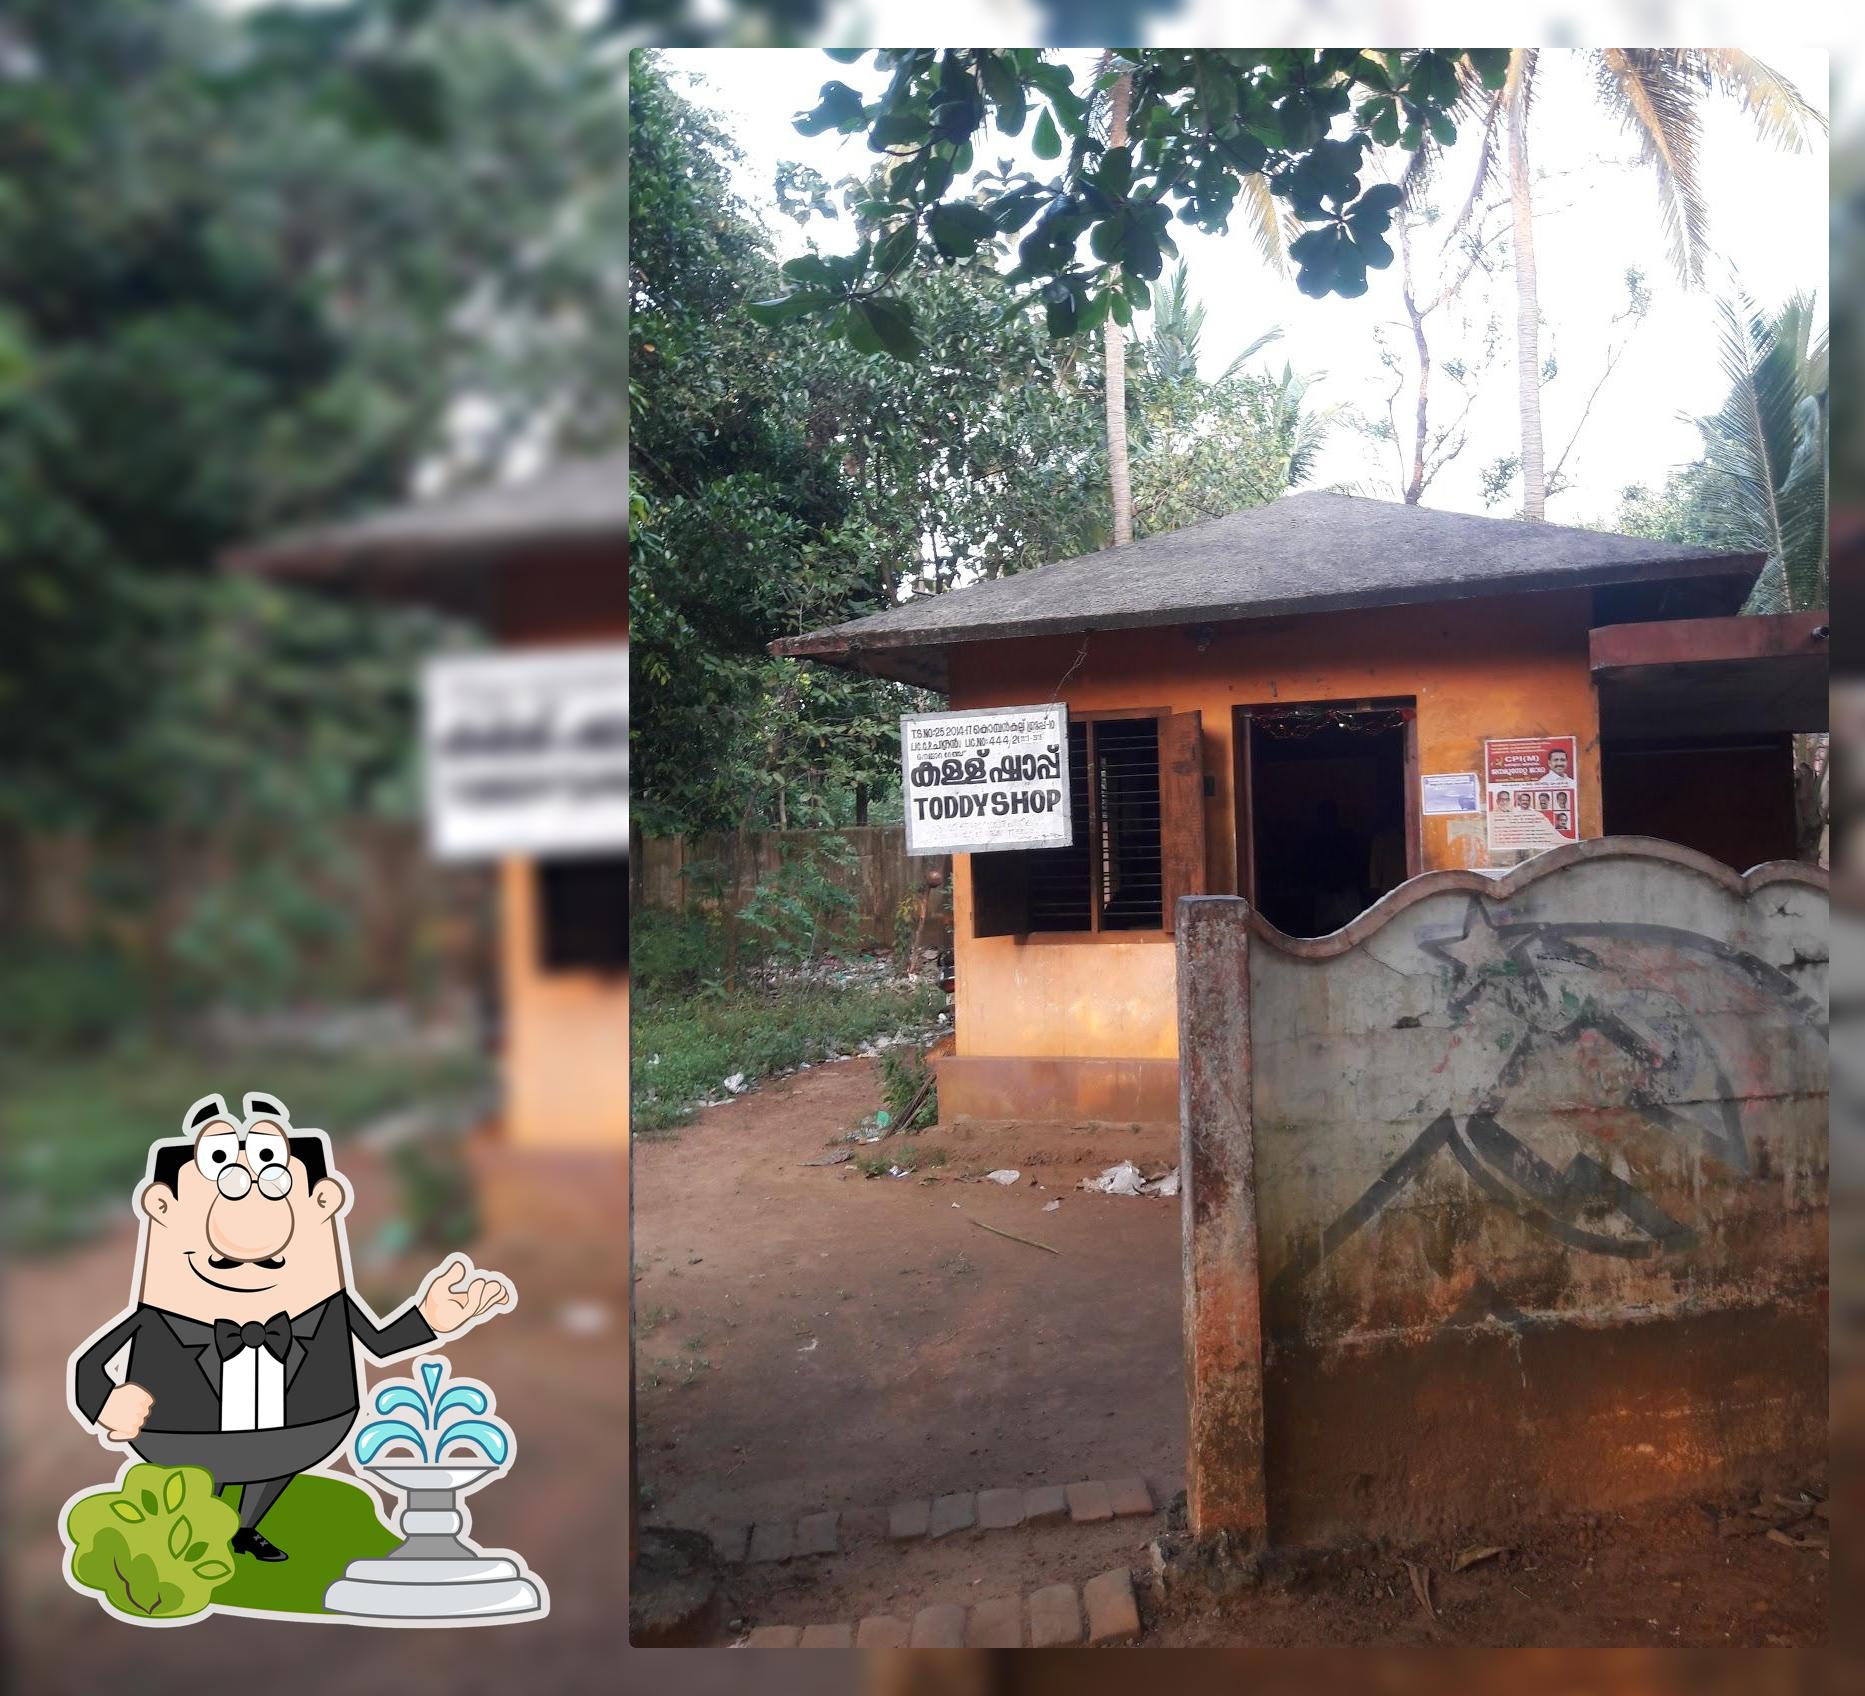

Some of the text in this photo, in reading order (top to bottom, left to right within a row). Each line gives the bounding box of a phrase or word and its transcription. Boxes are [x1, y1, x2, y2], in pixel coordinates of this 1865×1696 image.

[1504, 755, 1540, 763] CPI(M)
[914, 789, 1062, 821] TODDY SHOP
